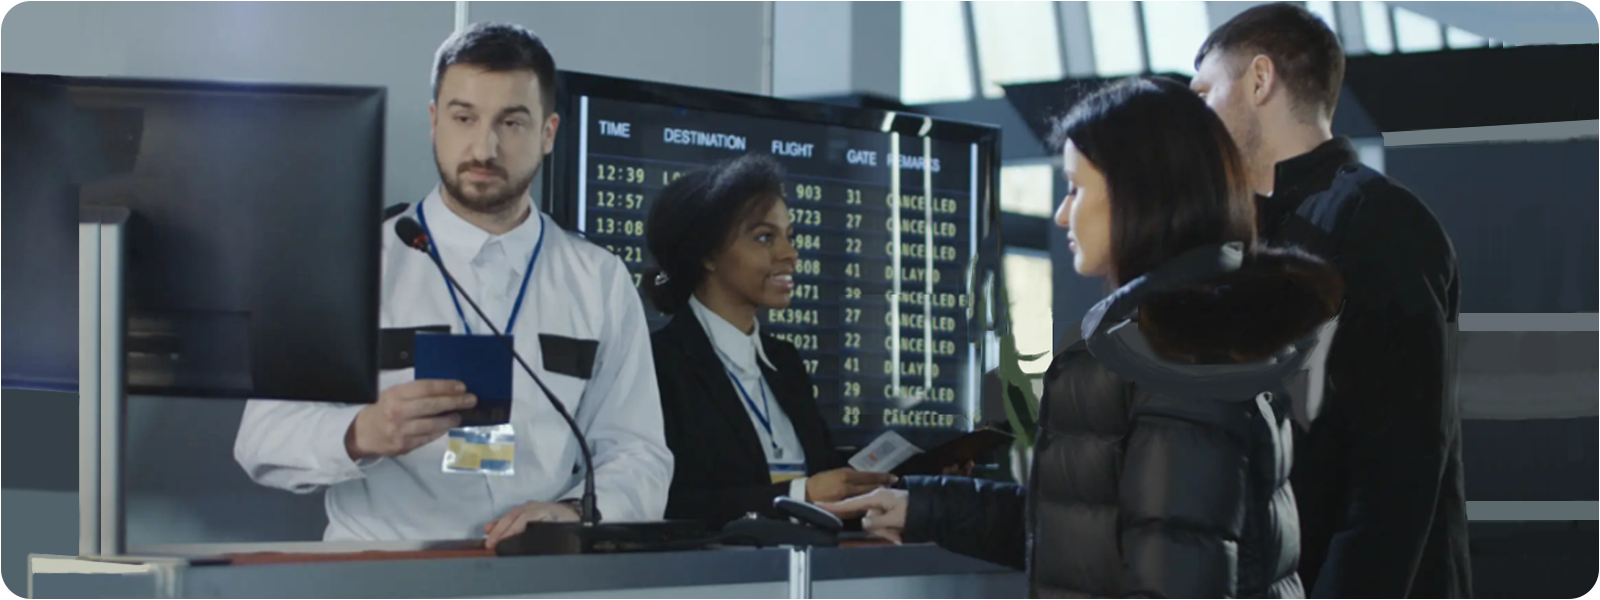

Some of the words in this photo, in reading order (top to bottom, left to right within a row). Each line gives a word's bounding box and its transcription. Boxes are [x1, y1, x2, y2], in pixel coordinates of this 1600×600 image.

[599, 120, 631, 138] TIME
[663, 127, 746, 150] DESTINATION
[771, 140, 814, 158] FLIGHT
[846, 149, 877, 166] GATE
[886, 152, 941, 173] REMARS
[597, 164, 645, 184] 12:39
[796, 184, 822, 201] 903
[846, 188, 862, 205] 31
[885, 193, 957, 214] CNCELED
[597, 191, 644, 210] 12:57
[846, 213, 863, 229] 27
[885, 217, 957, 238] CNCELED
[596, 217, 644, 236] 13:08
[845, 237, 862, 254] 22
[885, 241, 957, 262] CNCELED
[845, 262, 861, 279] 41
[884, 265, 941, 284] DLAYD
[885, 290, 956, 308] CNCELED
[768, 308, 819, 326] EK3941
[845, 307, 862, 323] 27
[884, 311, 956, 332] CNCELED
[844, 332, 861, 349] 22
[884, 335, 956, 356] CNCELED
[844, 357, 860, 374] 41
[883, 360, 940, 378] DLAYD
